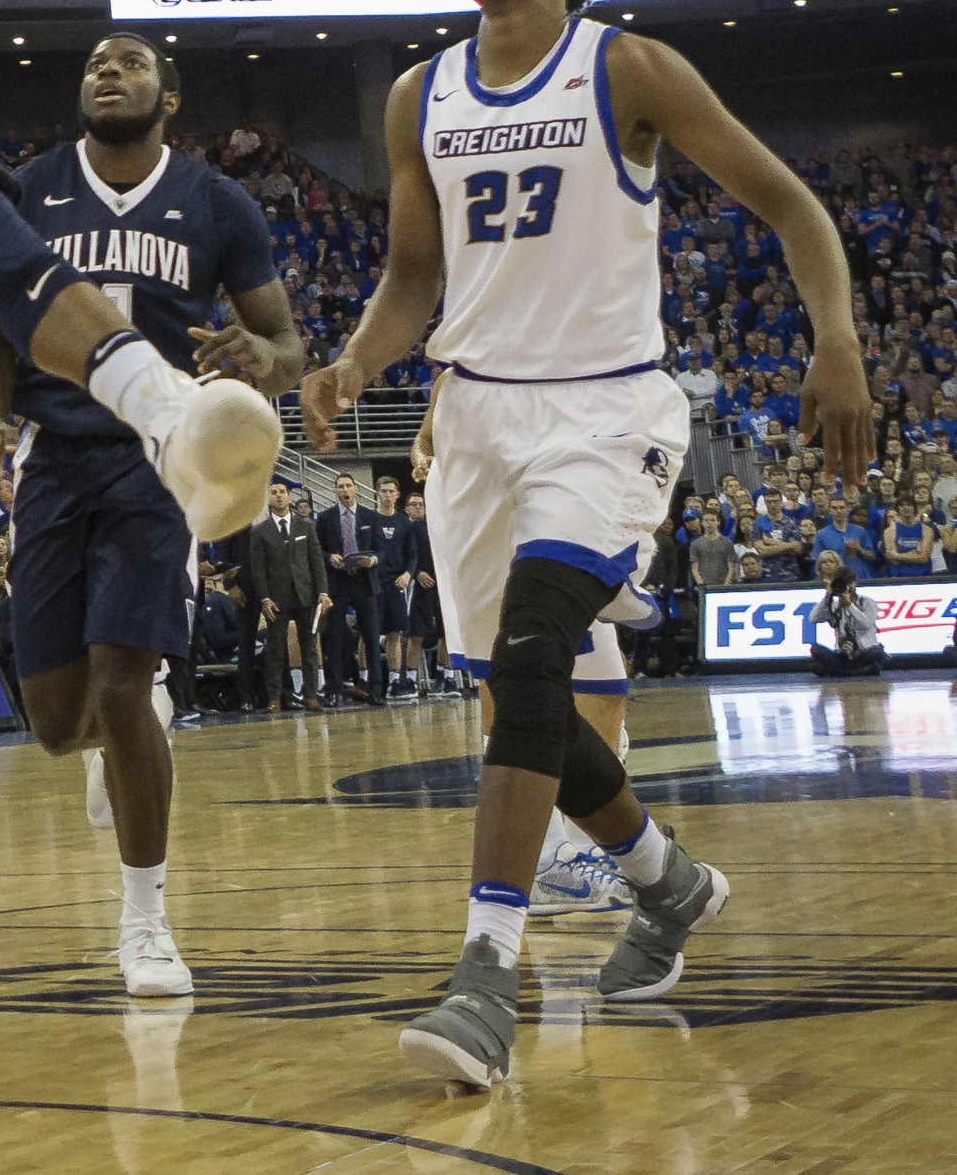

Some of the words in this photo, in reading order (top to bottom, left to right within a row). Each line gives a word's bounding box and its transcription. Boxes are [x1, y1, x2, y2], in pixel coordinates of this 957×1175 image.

[434, 122, 586, 158] CREIGHTON
[464, 165, 564, 245] 23
[717, 602, 818, 647] FS1
